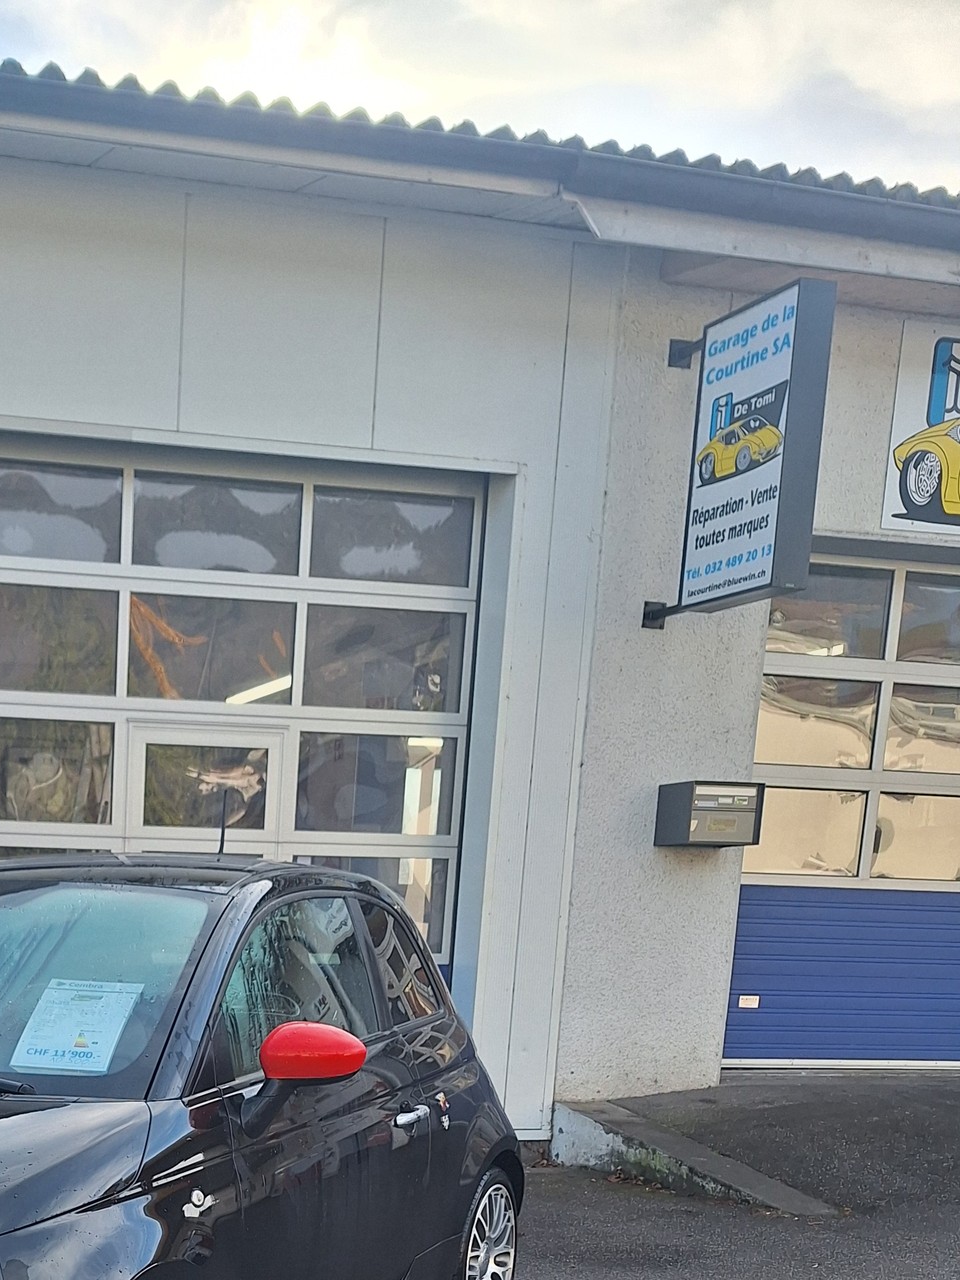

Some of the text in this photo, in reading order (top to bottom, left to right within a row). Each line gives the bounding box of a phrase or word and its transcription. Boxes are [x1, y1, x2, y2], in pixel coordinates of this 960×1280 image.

[708, 304, 795, 358] Garage de la
[706, 332, 791, 385] Courtine SA
[734, 404, 748, 418] De
[691, 496, 744, 528] Réparation
[750, 484, 778, 508] Vente
[695, 514, 770, 550] toutes marques
[686, 543, 772, 581] Tél. 032 489 20 13
[688, 569, 766, 598] lacourtine@bluewin.ch
[26, 1048, 50, 1056] CHF
